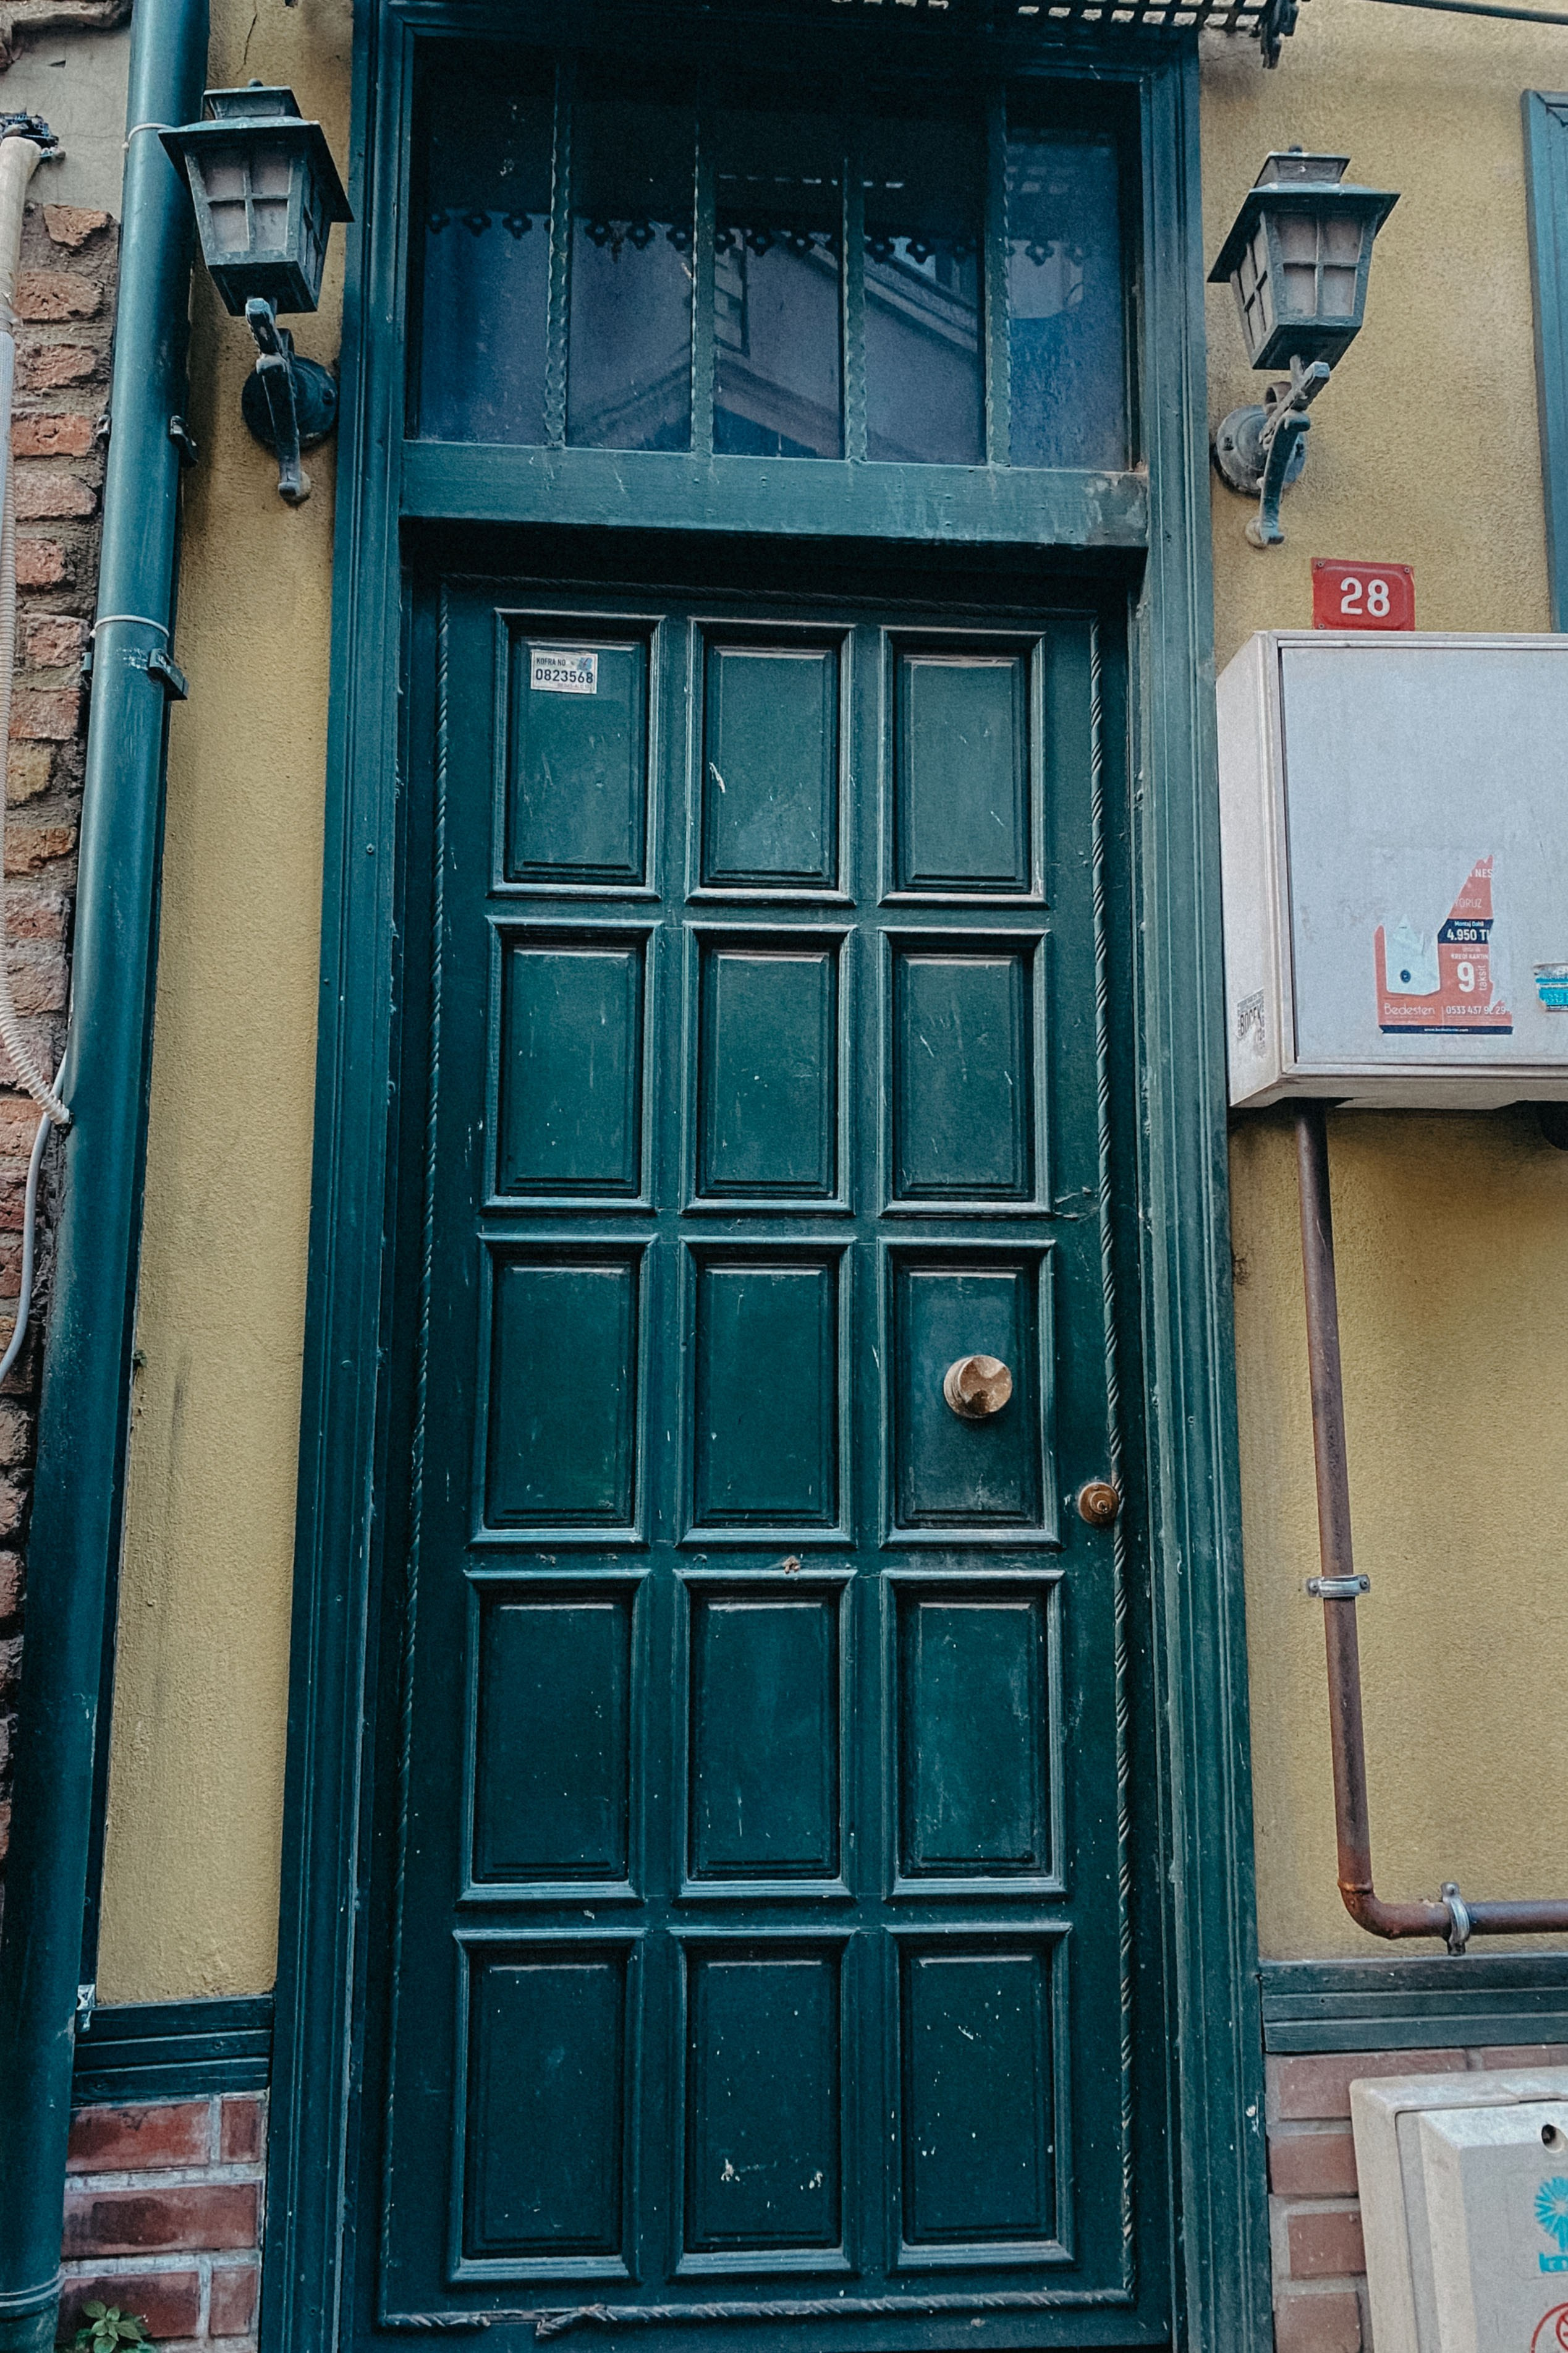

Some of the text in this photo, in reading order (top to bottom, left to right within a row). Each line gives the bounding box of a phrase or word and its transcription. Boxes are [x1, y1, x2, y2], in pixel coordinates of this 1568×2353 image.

[1341, 577, 1390, 617] 28
[536, 657, 566, 666] KOFRA NO
[535, 668, 593, 684] 0823568
[1447, 929, 1477, 941] 4.950
[1457, 961, 1474, 992] 9
[1477, 964, 1488, 990] taksit
[1384, 1003, 1435, 1015] Bedesten
[1446, 1005, 1466, 1015] 0533
[1467, 1005, 1481, 1015] 437
